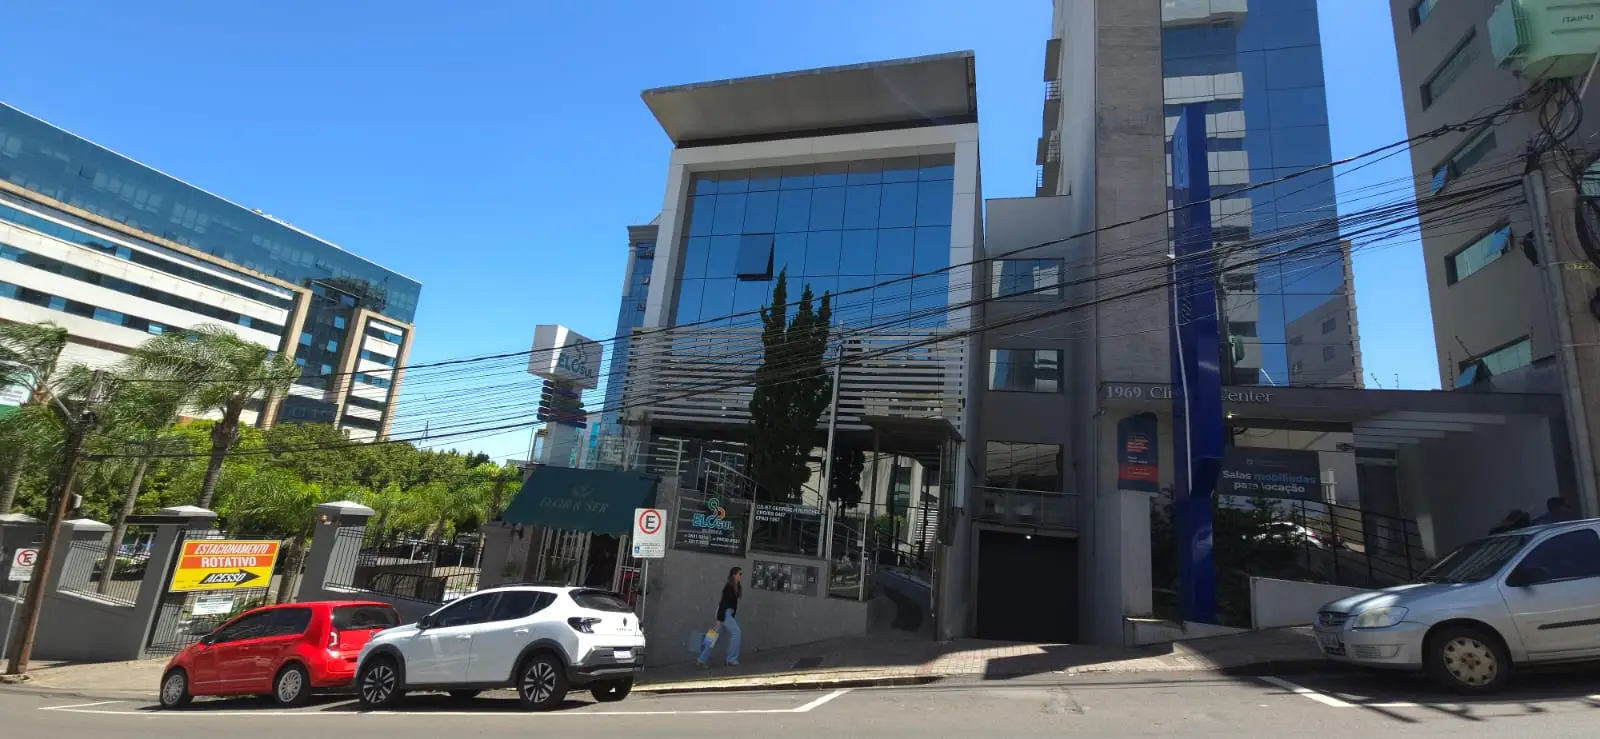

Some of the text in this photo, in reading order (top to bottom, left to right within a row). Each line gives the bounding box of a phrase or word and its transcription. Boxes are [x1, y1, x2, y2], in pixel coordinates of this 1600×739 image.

[1562, 13, 1594, 23] ITAIPU
[1106, 386, 1142, 399] 1969
[1224, 388, 1273, 402] enter
[1222, 470, 1252, 480] Salas
[645, 515, 656, 529] E
[194, 543, 270, 555] ESTACIONAMENTO
[201, 556, 257, 568] ROTATIVO
[204, 572, 247, 583] ACESSO
